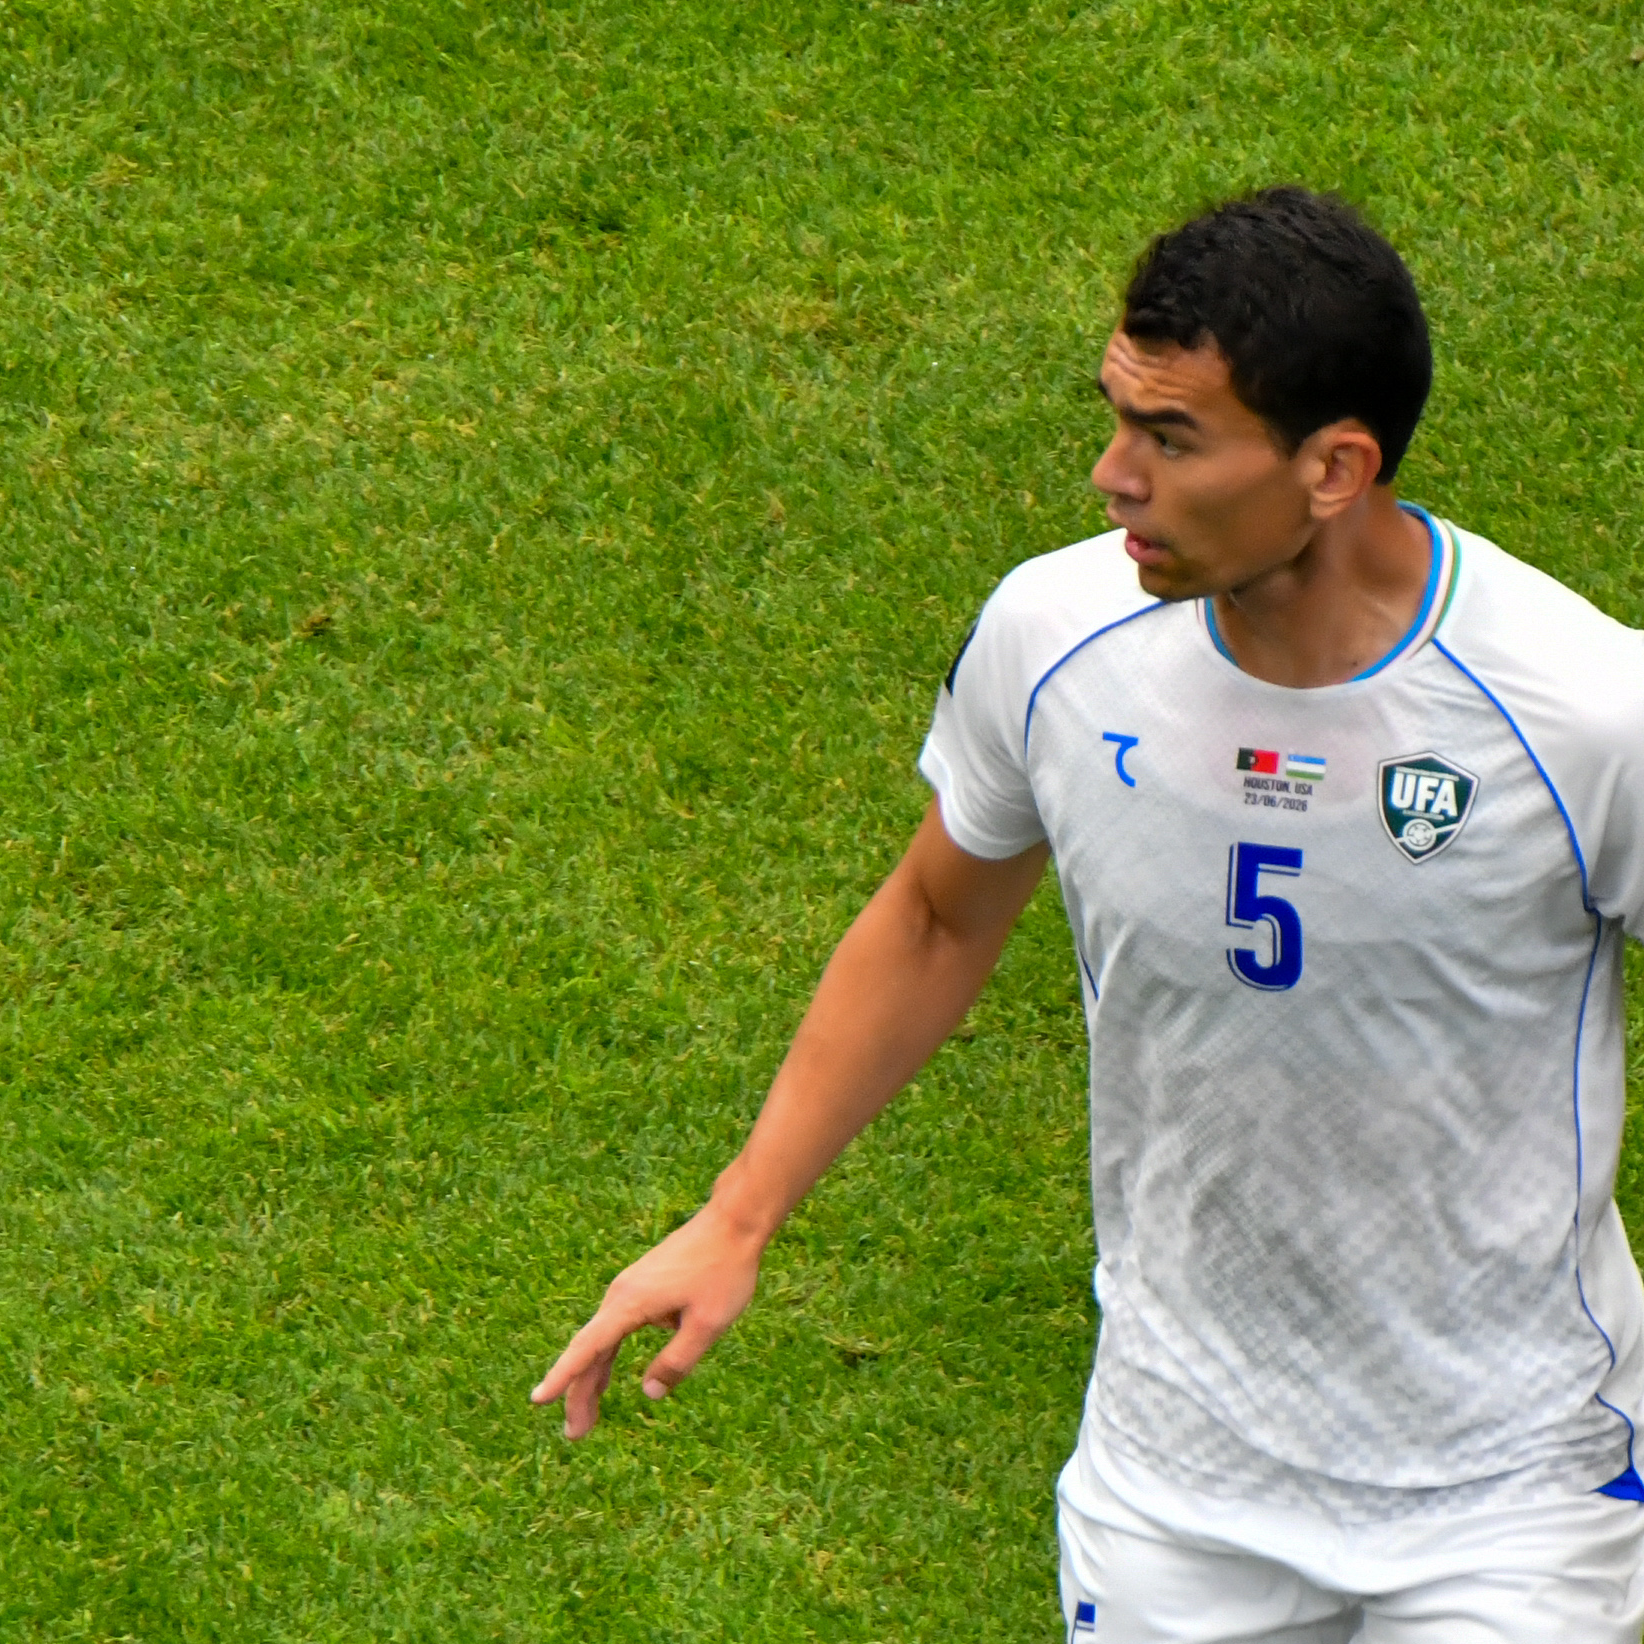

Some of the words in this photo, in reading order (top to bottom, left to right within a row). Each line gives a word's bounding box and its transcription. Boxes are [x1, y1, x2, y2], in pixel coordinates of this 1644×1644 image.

[1294, 782, 1313, 796] USA
[1390, 771, 1458, 817] UFA
[1225, 840, 1303, 992] 5
